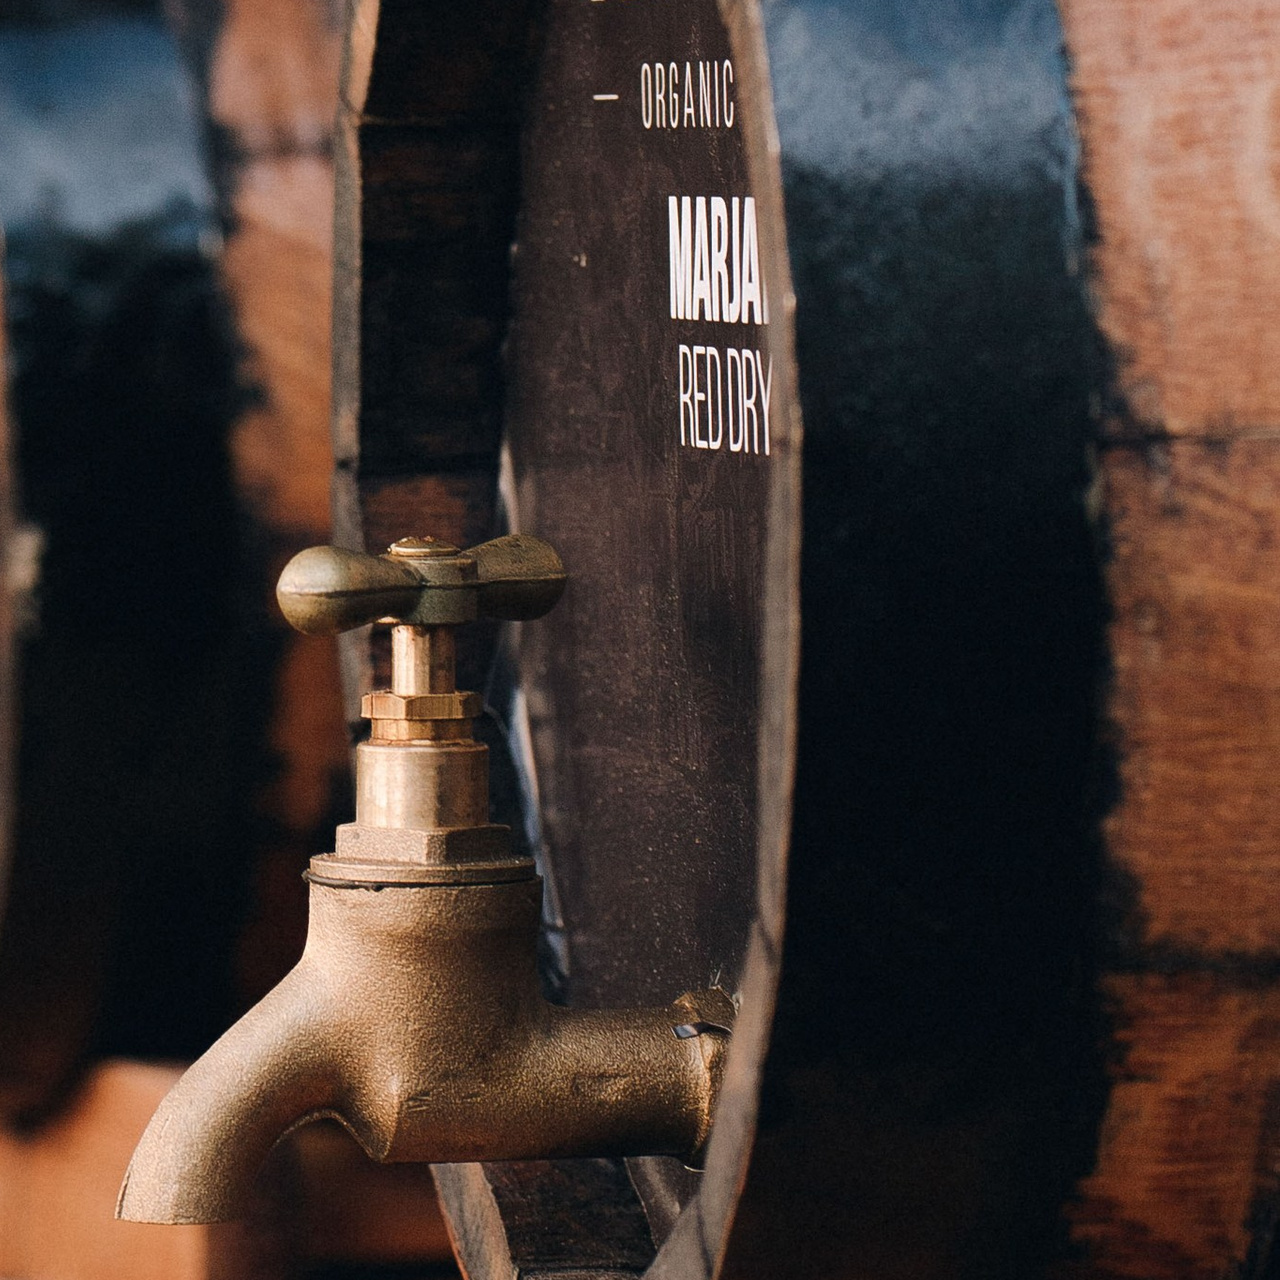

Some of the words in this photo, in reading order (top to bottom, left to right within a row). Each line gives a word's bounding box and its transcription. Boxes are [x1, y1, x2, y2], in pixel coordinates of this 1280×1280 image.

[640, 59, 734, 129] ORGANIC
[668, 195, 770, 325] MARJA
[679, 344, 723, 450] RED
[726, 347, 773, 456] DRY
